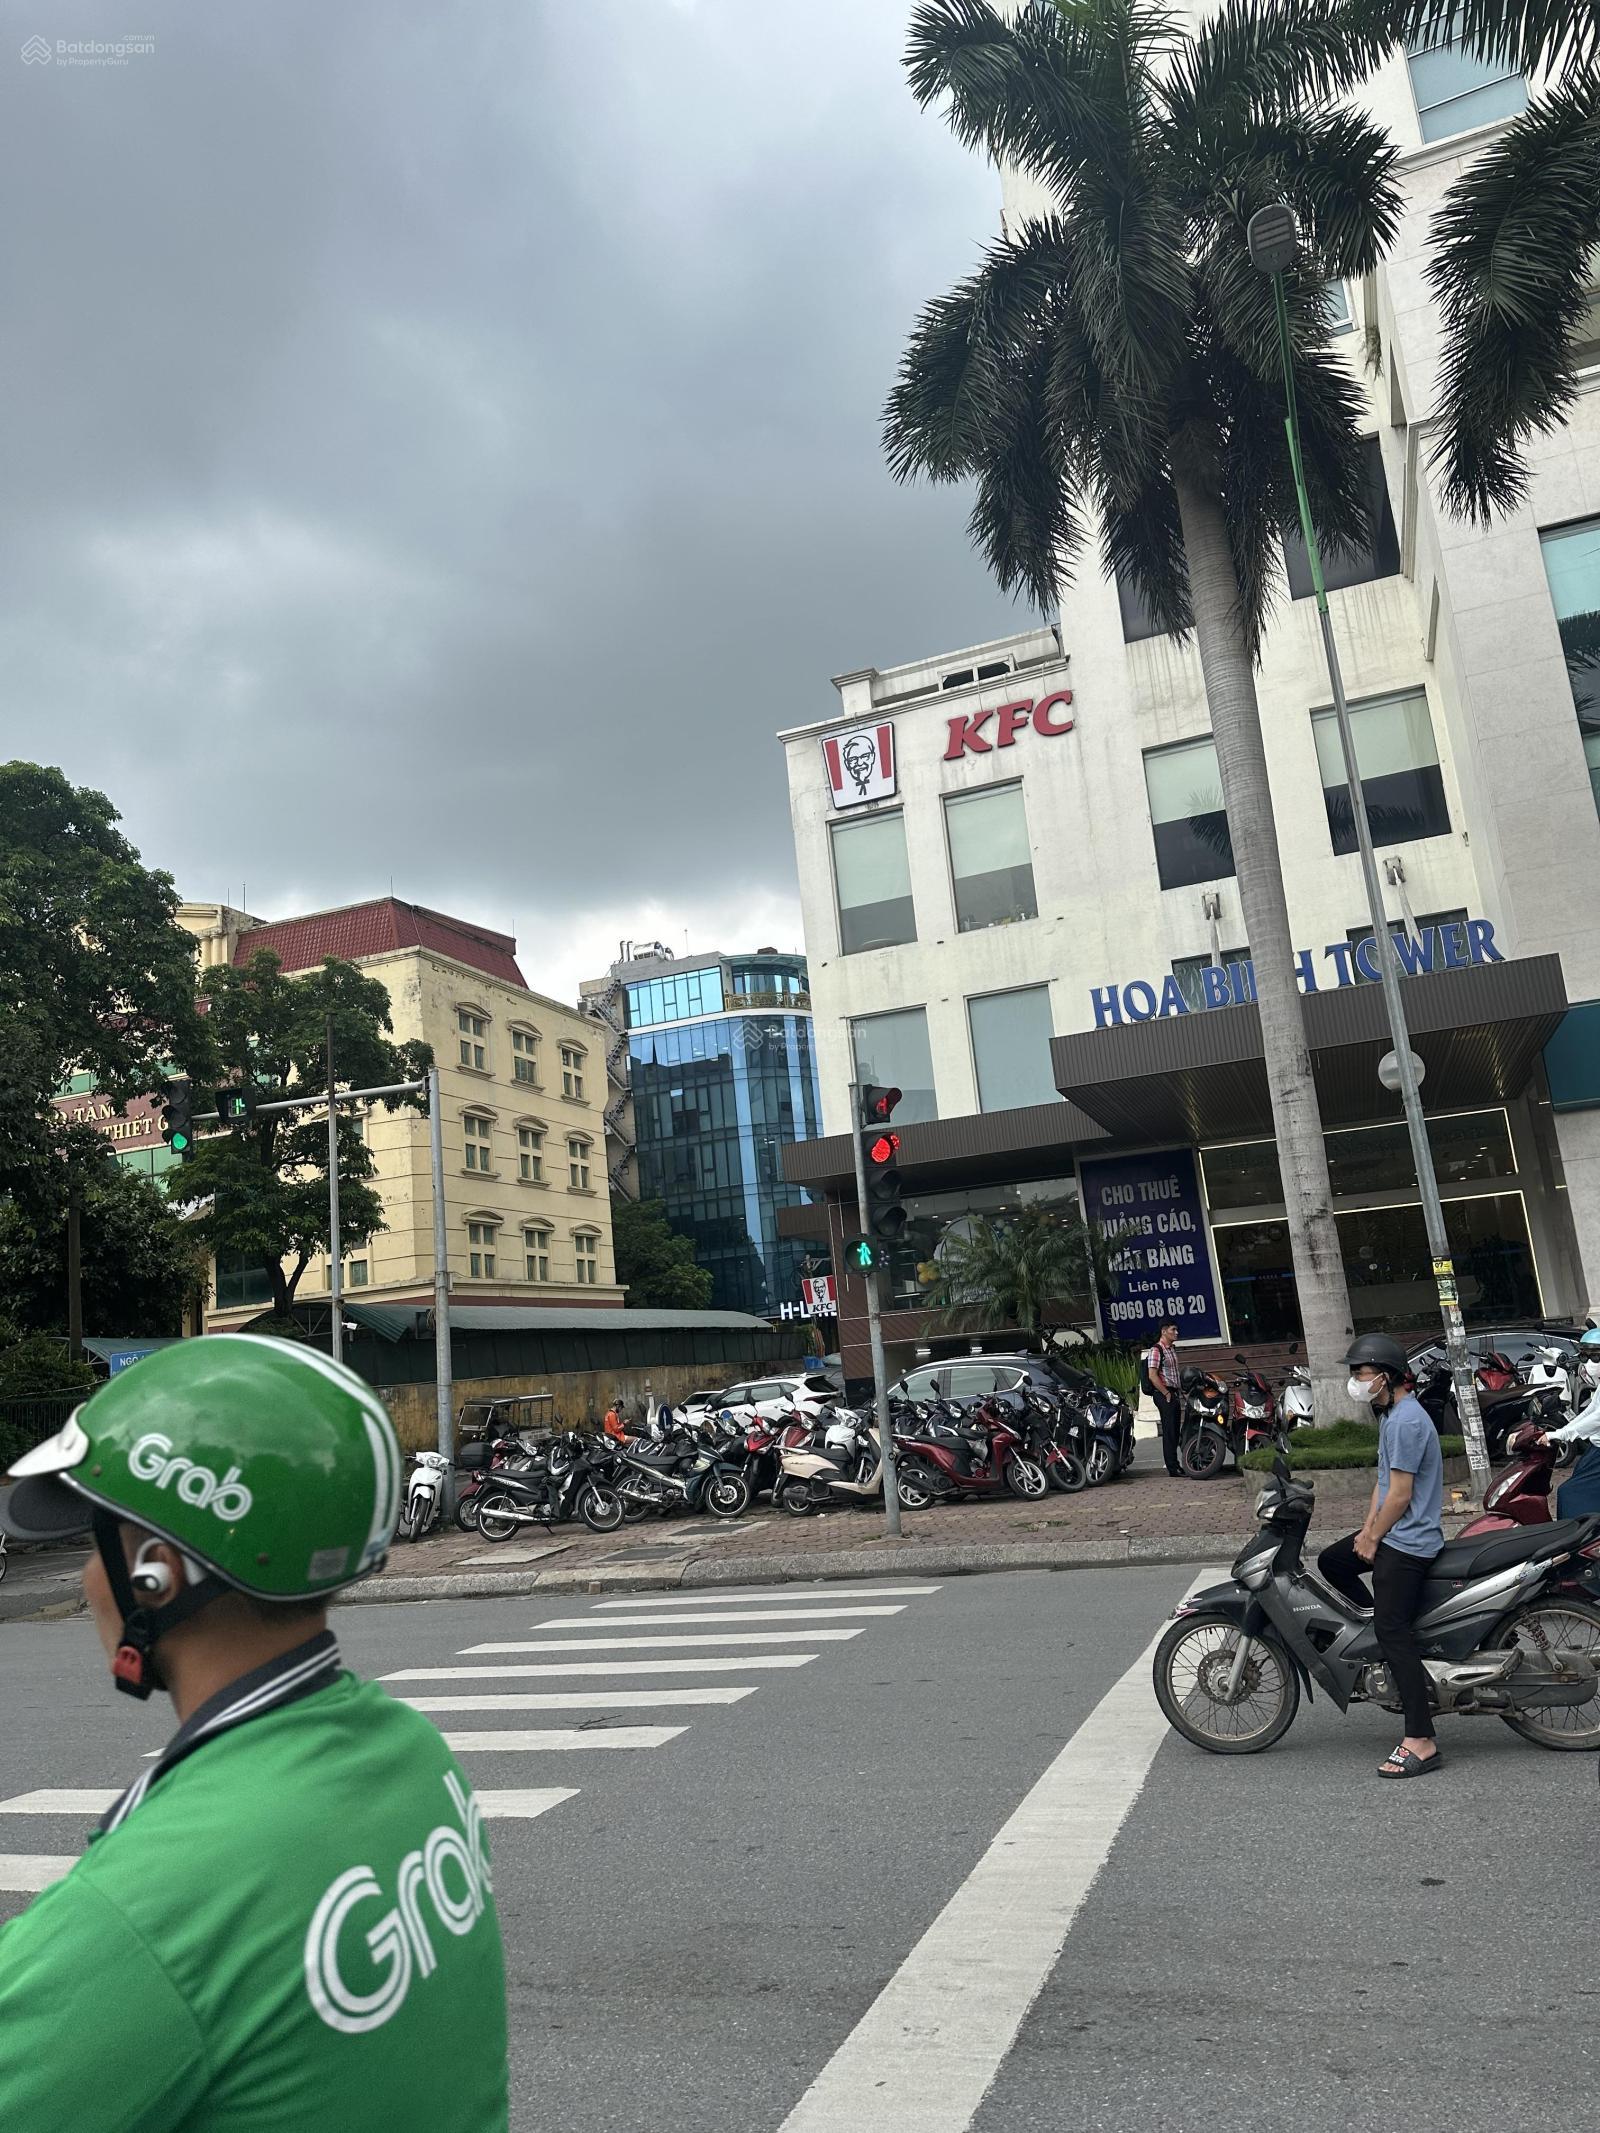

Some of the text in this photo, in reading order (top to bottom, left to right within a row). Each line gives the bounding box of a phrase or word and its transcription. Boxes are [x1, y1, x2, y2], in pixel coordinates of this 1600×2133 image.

[943, 689, 1074, 761] KFC
[1089, 918, 1506, 1029] HOA BIH TOWER
[74, 1100, 116, 1123] TÀN
[1101, 1174, 1181, 1206] CHO THUÊ
[1156, 1208, 1197, 1233] CÁO,
[1146, 1240, 1195, 1268] BẰNG
[1128, 1278, 1180, 1293] Liên hệ
[812, 1302, 833, 1313] KFC
[1110, 1294, 1206, 1321] 0969 68 68 20
[128, 1433, 252, 1522] Grab
[1292, 1603, 1322, 1613] HONDA
